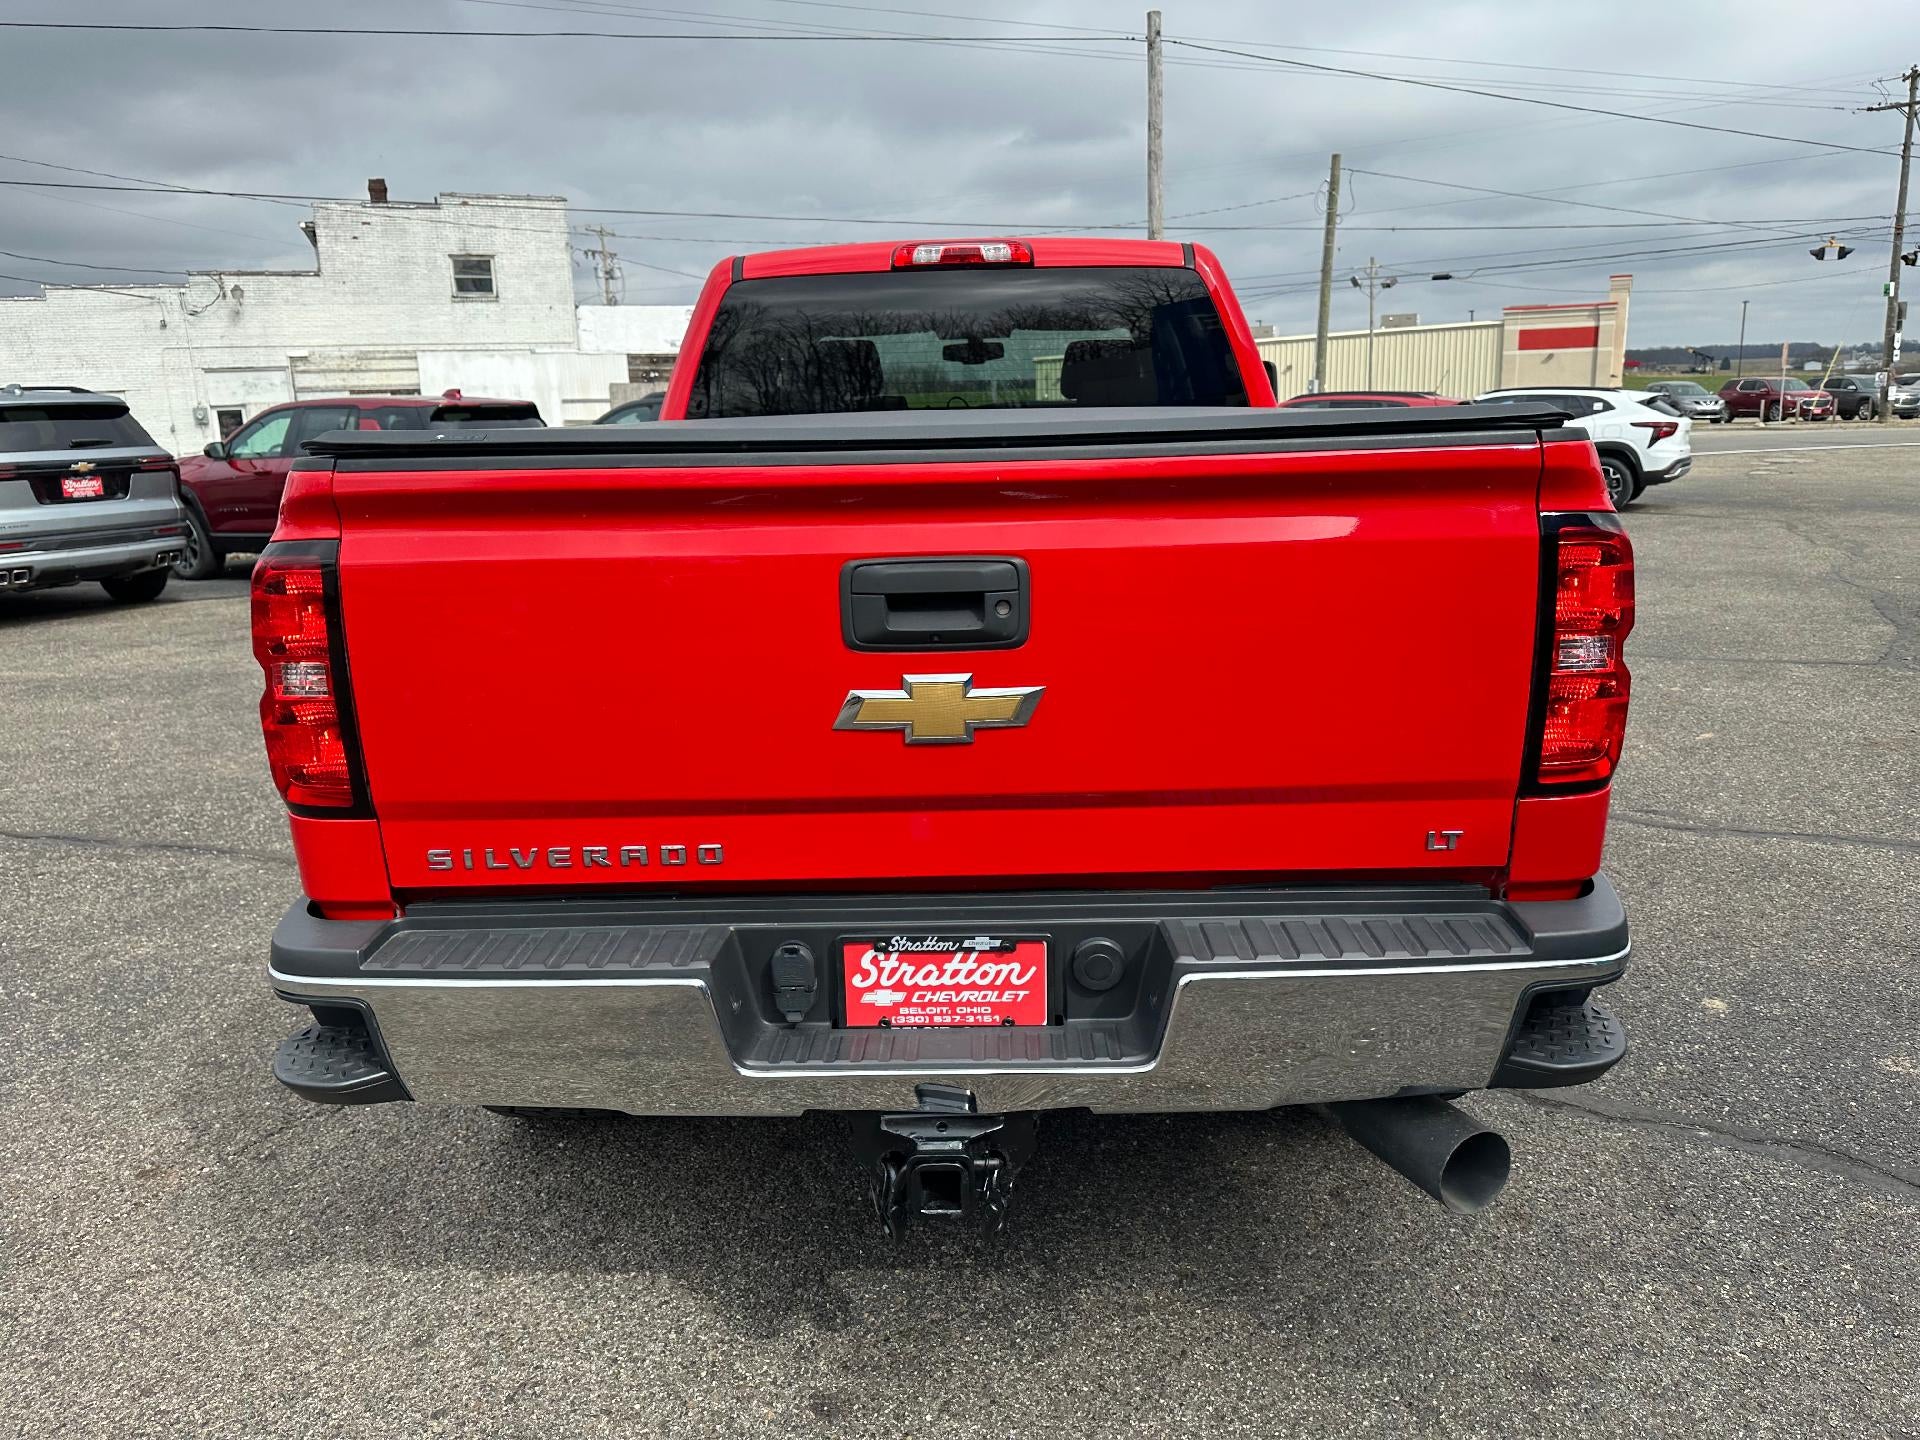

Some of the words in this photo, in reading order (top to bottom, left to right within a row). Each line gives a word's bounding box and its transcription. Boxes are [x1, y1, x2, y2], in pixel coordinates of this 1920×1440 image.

[63, 479, 100, 489] Stratton
[1427, 830, 1464, 850] LT
[427, 844, 724, 870] SILVERADO
[888, 935, 960, 952] Stratton
[851, 949, 1038, 988] Stratton
[911, 990, 1030, 1003] CHEVROLET
[899, 1006, 952, 1015] BELOIT,
[956, 1006, 992, 1014] OHIO
[891, 1015, 930, 1024] (330)
